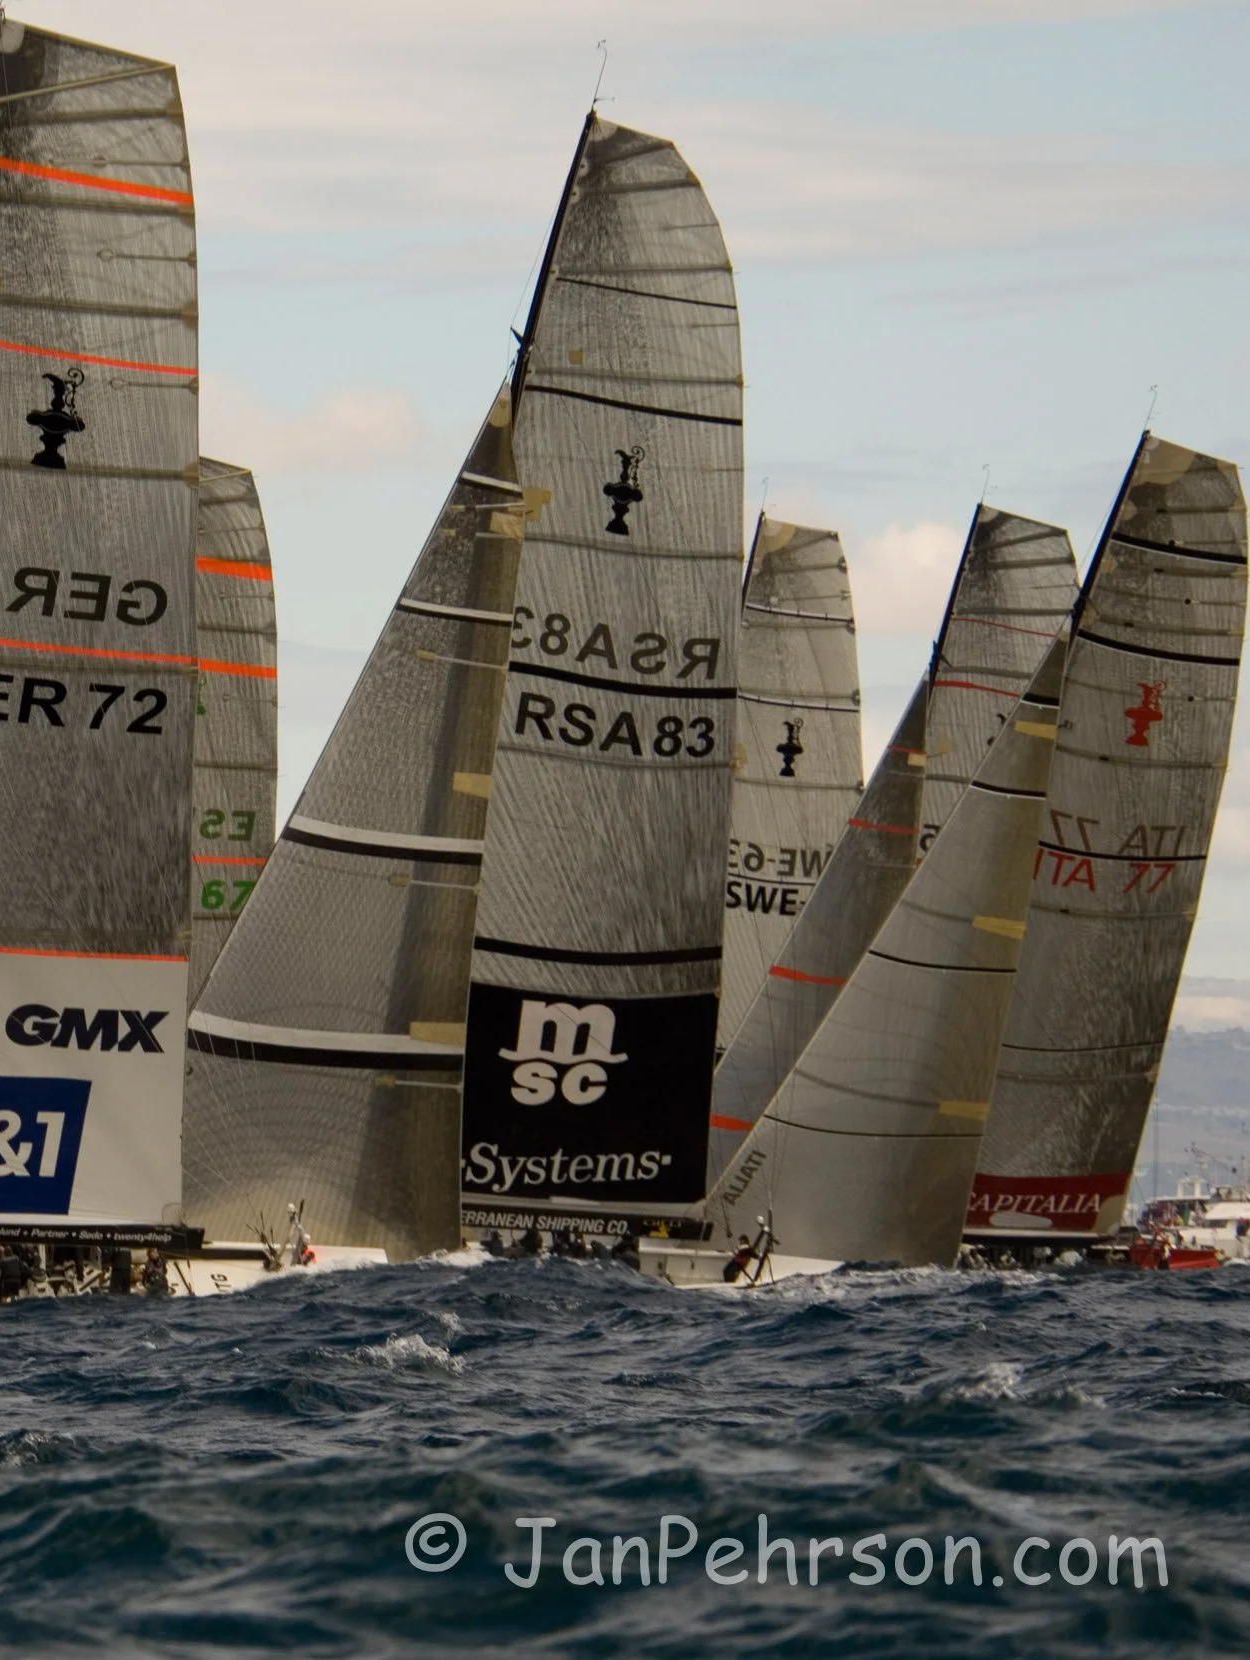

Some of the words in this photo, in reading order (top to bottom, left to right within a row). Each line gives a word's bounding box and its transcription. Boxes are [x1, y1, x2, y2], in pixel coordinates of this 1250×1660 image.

[89, 683, 168, 735] 72
[1033, 849, 1096, 892] ITA
[1122, 863, 1175, 893] 77
[6, 1004, 170, 1053] GMX
[536, 1215, 604, 1233] SHIPPING
